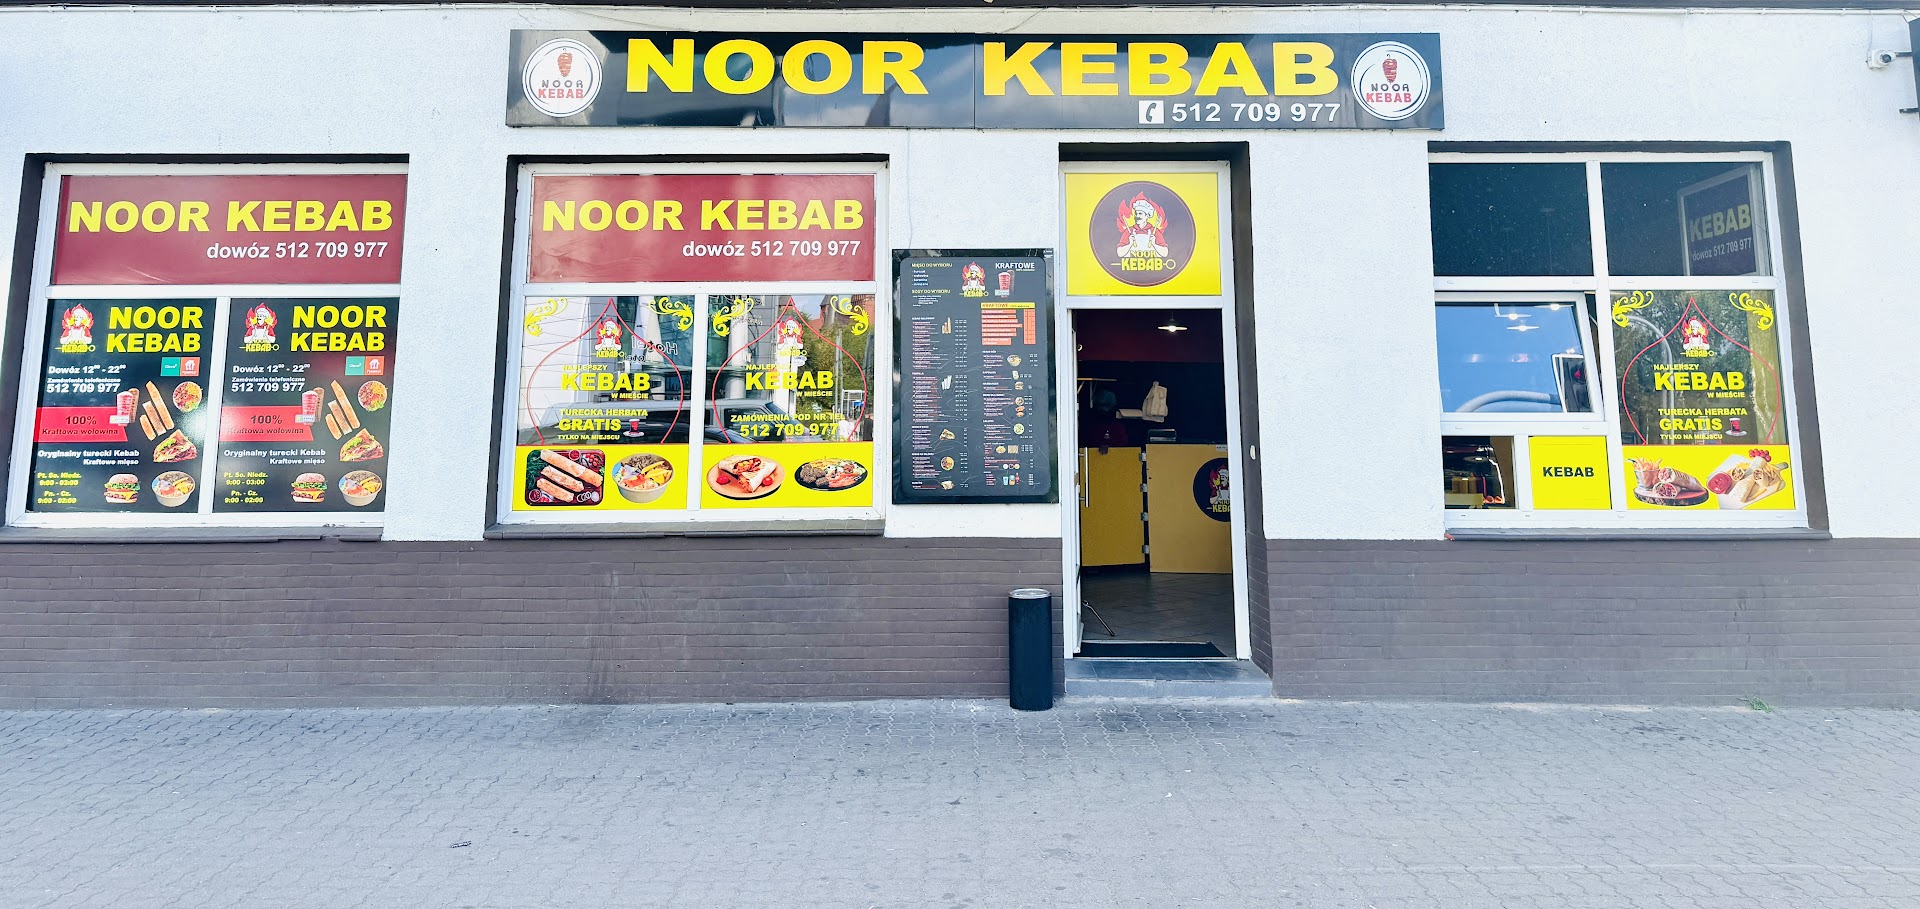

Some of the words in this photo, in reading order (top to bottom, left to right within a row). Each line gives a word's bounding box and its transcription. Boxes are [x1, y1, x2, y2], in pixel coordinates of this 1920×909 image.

[626, 38, 929, 95] NOOR
[983, 41, 1339, 96] KEBAB
[542, 79, 583, 88] NOOR
[1371, 83, 1409, 92] NOOR
[538, 89, 584, 98] KEBAB
[1366, 92, 1412, 103] KEBAB
[1171, 103, 1221, 122] 512
[1233, 103, 1281, 122] 709
[1290, 102, 1341, 122] 977
[68, 201, 210, 233] NOOR
[226, 200, 393, 232] KEBAB
[543, 200, 684, 231] NOOR
[700, 199, 864, 231] KEBAB
[1689, 204, 1752, 242] KEBAB
[206, 242, 270, 260] dowóz
[275, 243, 308, 258] 512
[315, 242, 348, 258] 709
[353, 241, 388, 257] 977
[682, 240, 745, 257] dowóz
[750, 241, 783, 256] 512
[789, 241, 822, 256] 709
[827, 240, 861, 256] 977
[1713, 244, 1726, 257] 512
[1726, 241, 1739, 254] 709
[1740, 237, 1752, 250] 977
[1122, 257, 1164, 271] KEBAB
[109, 306, 203, 329] NOOR
[292, 305, 387, 329] NOOR
[106, 333, 201, 353] KEBAB
[246, 343, 271, 352] KEBAB
[290, 332, 385, 352] KEBAB
[49, 366, 80, 374] Dowóz
[233, 365, 264, 373] Dowóz
[560, 373, 650, 391] KEBAB
[745, 371, 834, 390] KEBAB
[1654, 372, 1745, 391] KEBAB
[46, 383, 69, 393] 512
[73, 383, 94, 393] 709
[97, 383, 120, 393] 977
[231, 383, 253, 392] 512
[257, 383, 279, 392] 709
[283, 383, 305, 392] 977
[605, 408, 648, 416] HERBATA
[731, 413, 789, 422] ZAMÓWIENIA
[793, 413, 811, 421] POD
[1658, 408, 1703, 416] TURECKA
[65, 416, 97, 425] 100%
[250, 415, 283, 425] 100%
[559, 419, 622, 431] GRATIS
[1659, 418, 1723, 430] GRATIS
[740, 424, 770, 437] 512
[775, 424, 804, 436] 709
[809, 423, 839, 435] 977
[224, 449, 268, 457] Oryginalny
[1542, 466, 1594, 478] KEBAB
